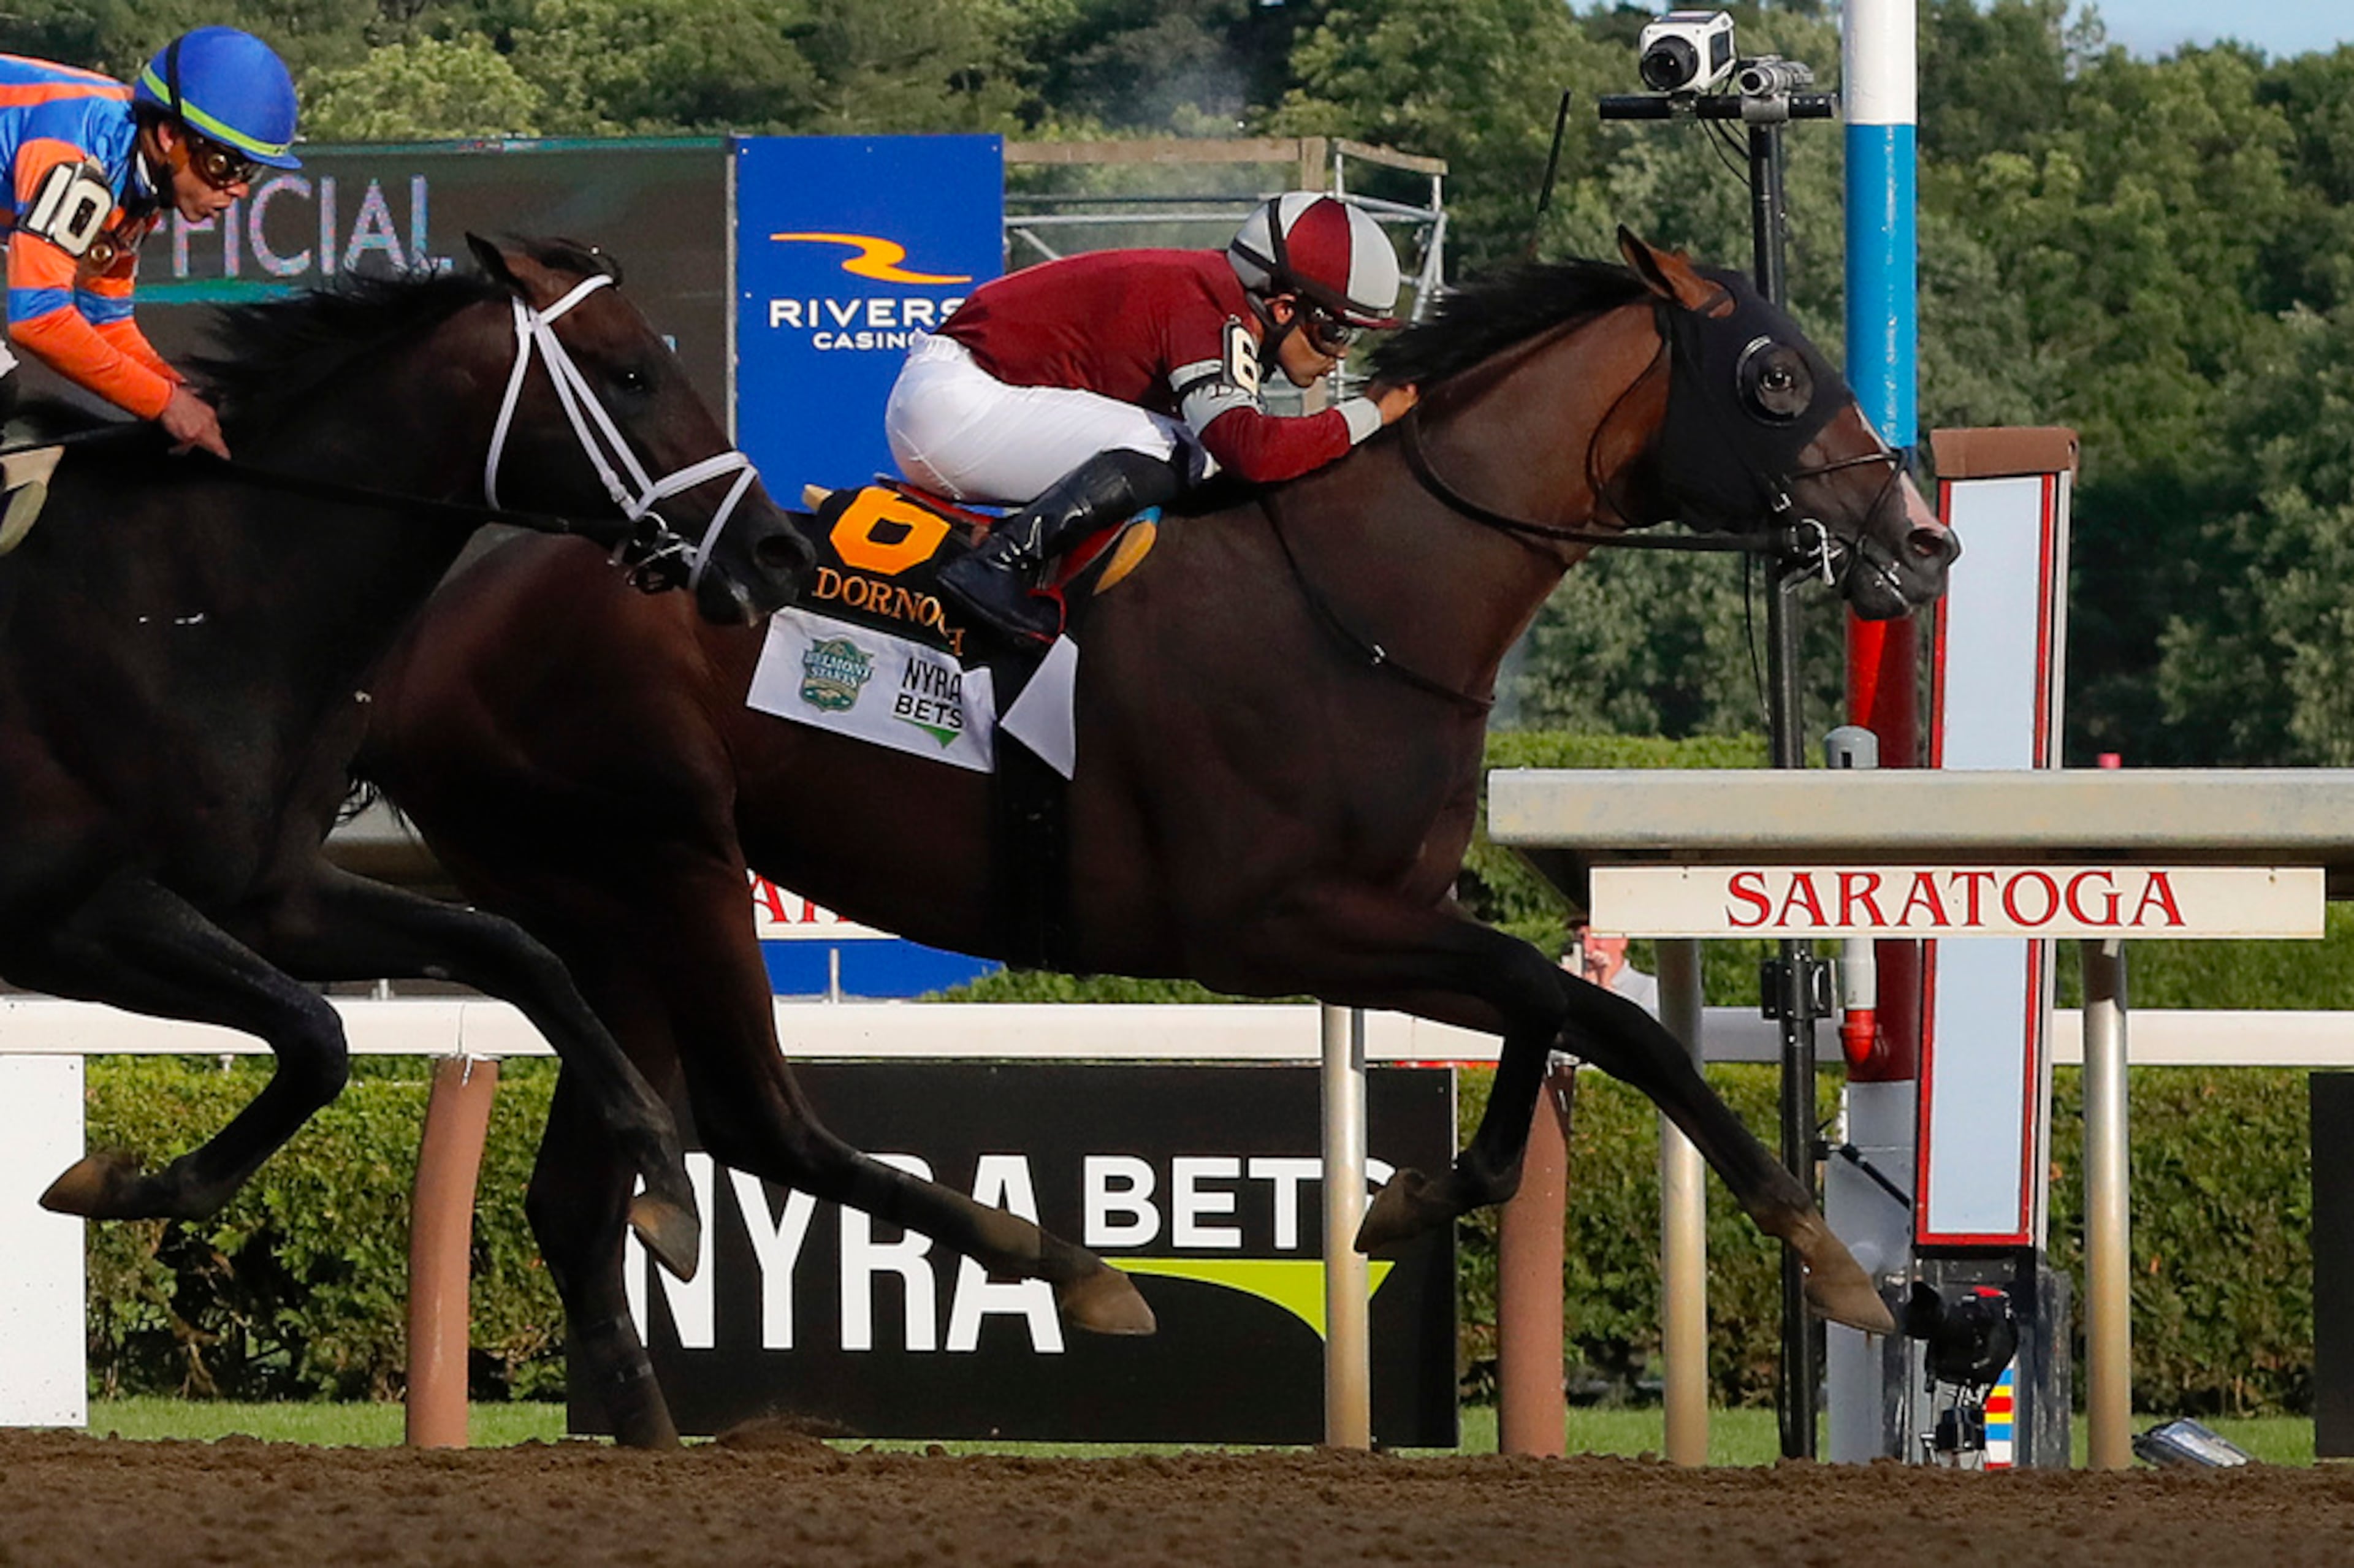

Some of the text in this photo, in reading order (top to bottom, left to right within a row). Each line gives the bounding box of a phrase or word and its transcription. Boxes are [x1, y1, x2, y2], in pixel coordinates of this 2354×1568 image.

[28, 164, 112, 256] 10
[152, 175, 453, 278] FICIAL
[1232, 326, 1262, 397] 6
[894, 693, 962, 728] BETS
[902, 657, 962, 705] NYRA
[1725, 870, 2187, 928] SARATOGA
[624, 1152, 1065, 1353] NYRA
